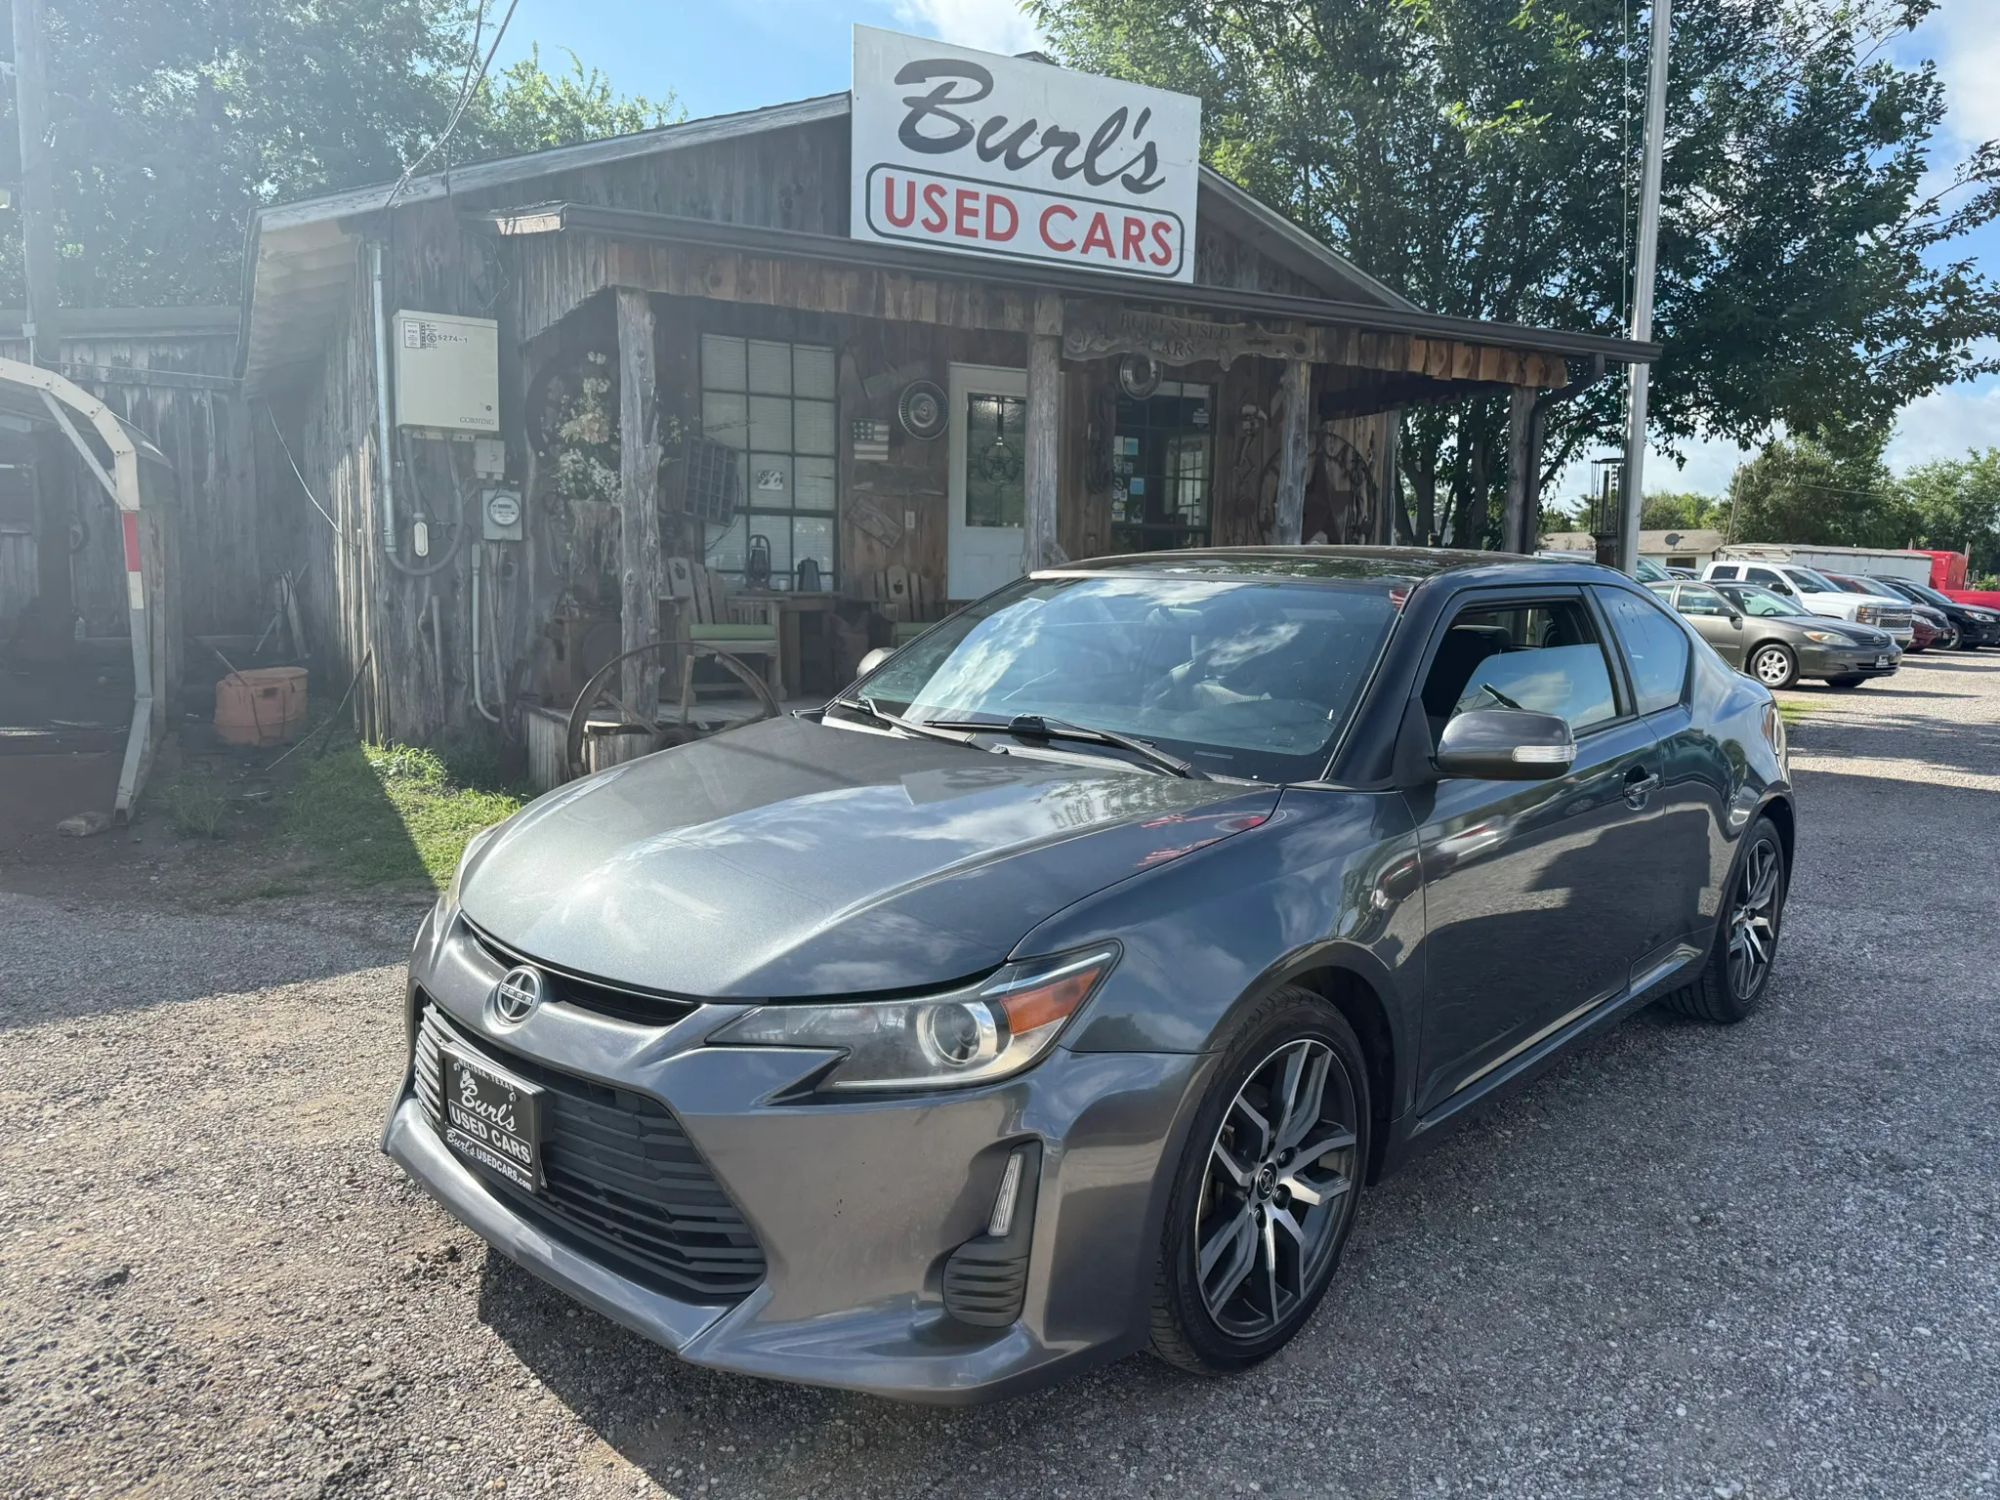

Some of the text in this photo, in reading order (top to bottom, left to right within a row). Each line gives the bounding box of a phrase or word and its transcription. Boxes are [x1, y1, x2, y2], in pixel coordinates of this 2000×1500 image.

[894, 58, 1166, 194] Burl's
[885, 176, 1174, 267] USED CARS
[451, 1105, 532, 1164] USED CARS
[461, 1083, 517, 1132] Burl's
